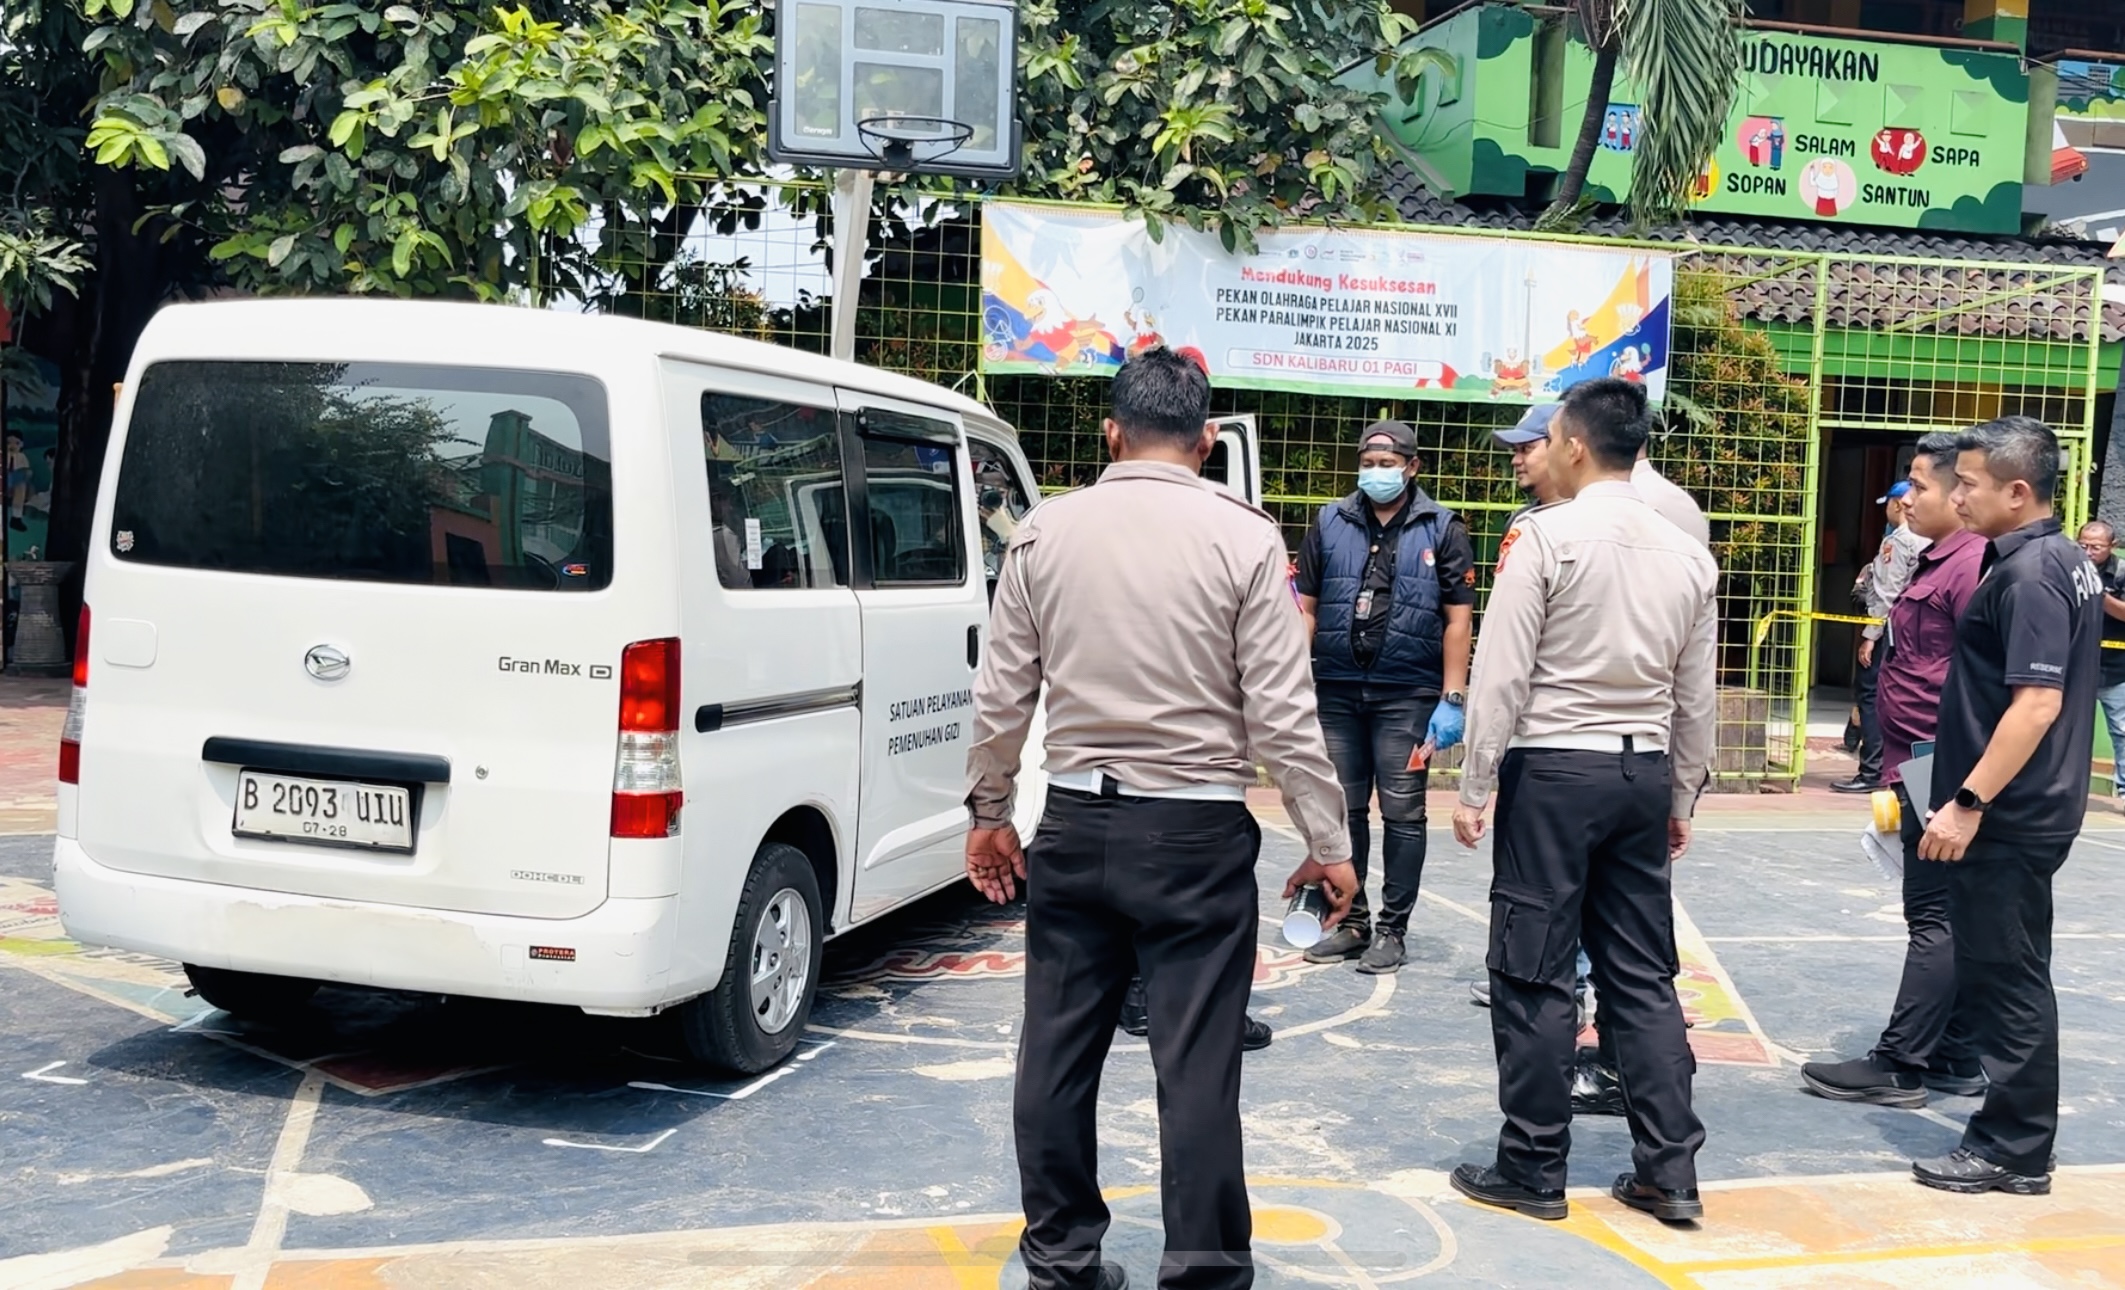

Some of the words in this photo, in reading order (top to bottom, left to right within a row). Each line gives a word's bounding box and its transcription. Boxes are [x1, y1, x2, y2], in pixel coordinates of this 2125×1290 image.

[1742, 40, 1879, 82] UDAYAKAN
[1795, 134, 1856, 157] SALAM
[1931, 146, 1980, 167] SAPA
[1727, 172, 1787, 196] SOPAN
[1862, 184, 1930, 208] SANTUN
[1241, 266, 1333, 292] Mendukung
[1338, 273, 1436, 295] Kesuksesan
[1216, 288, 1257, 304] PEKAN
[1260, 291, 1318, 310] OLAHRAGA
[1320, 298, 1371, 314] PELAJAR
[1374, 301, 1432, 317] NASIONAL
[1435, 304, 1458, 319] XVII
[1216, 307, 1257, 323] PEKAN
[1260, 309, 1327, 329] PARALIMPIK
[1329, 316, 1381, 333] PELAJAR
[1384, 319, 1442, 336] NASIONAL
[1445, 322, 1457, 337] XI
[1294, 332, 1343, 350] JAKARTA
[1346, 336, 1379, 351] 2025
[1253, 352, 1284, 367] SDN
[1288, 355, 1358, 373] KALIBARU
[1362, 359, 1380, 374] 01
[1384, 360, 1418, 375] PAGI
[498, 656, 541, 674] Gran
[544, 659, 581, 676] Max
[889, 697, 926, 722] SATUAN
[926, 689, 973, 714] PELAYANAN
[888, 725, 943, 757] PEMENUHAN
[944, 722, 961, 742] GIZI
[243, 778, 259, 811] B
[273, 782, 338, 819] 2093
